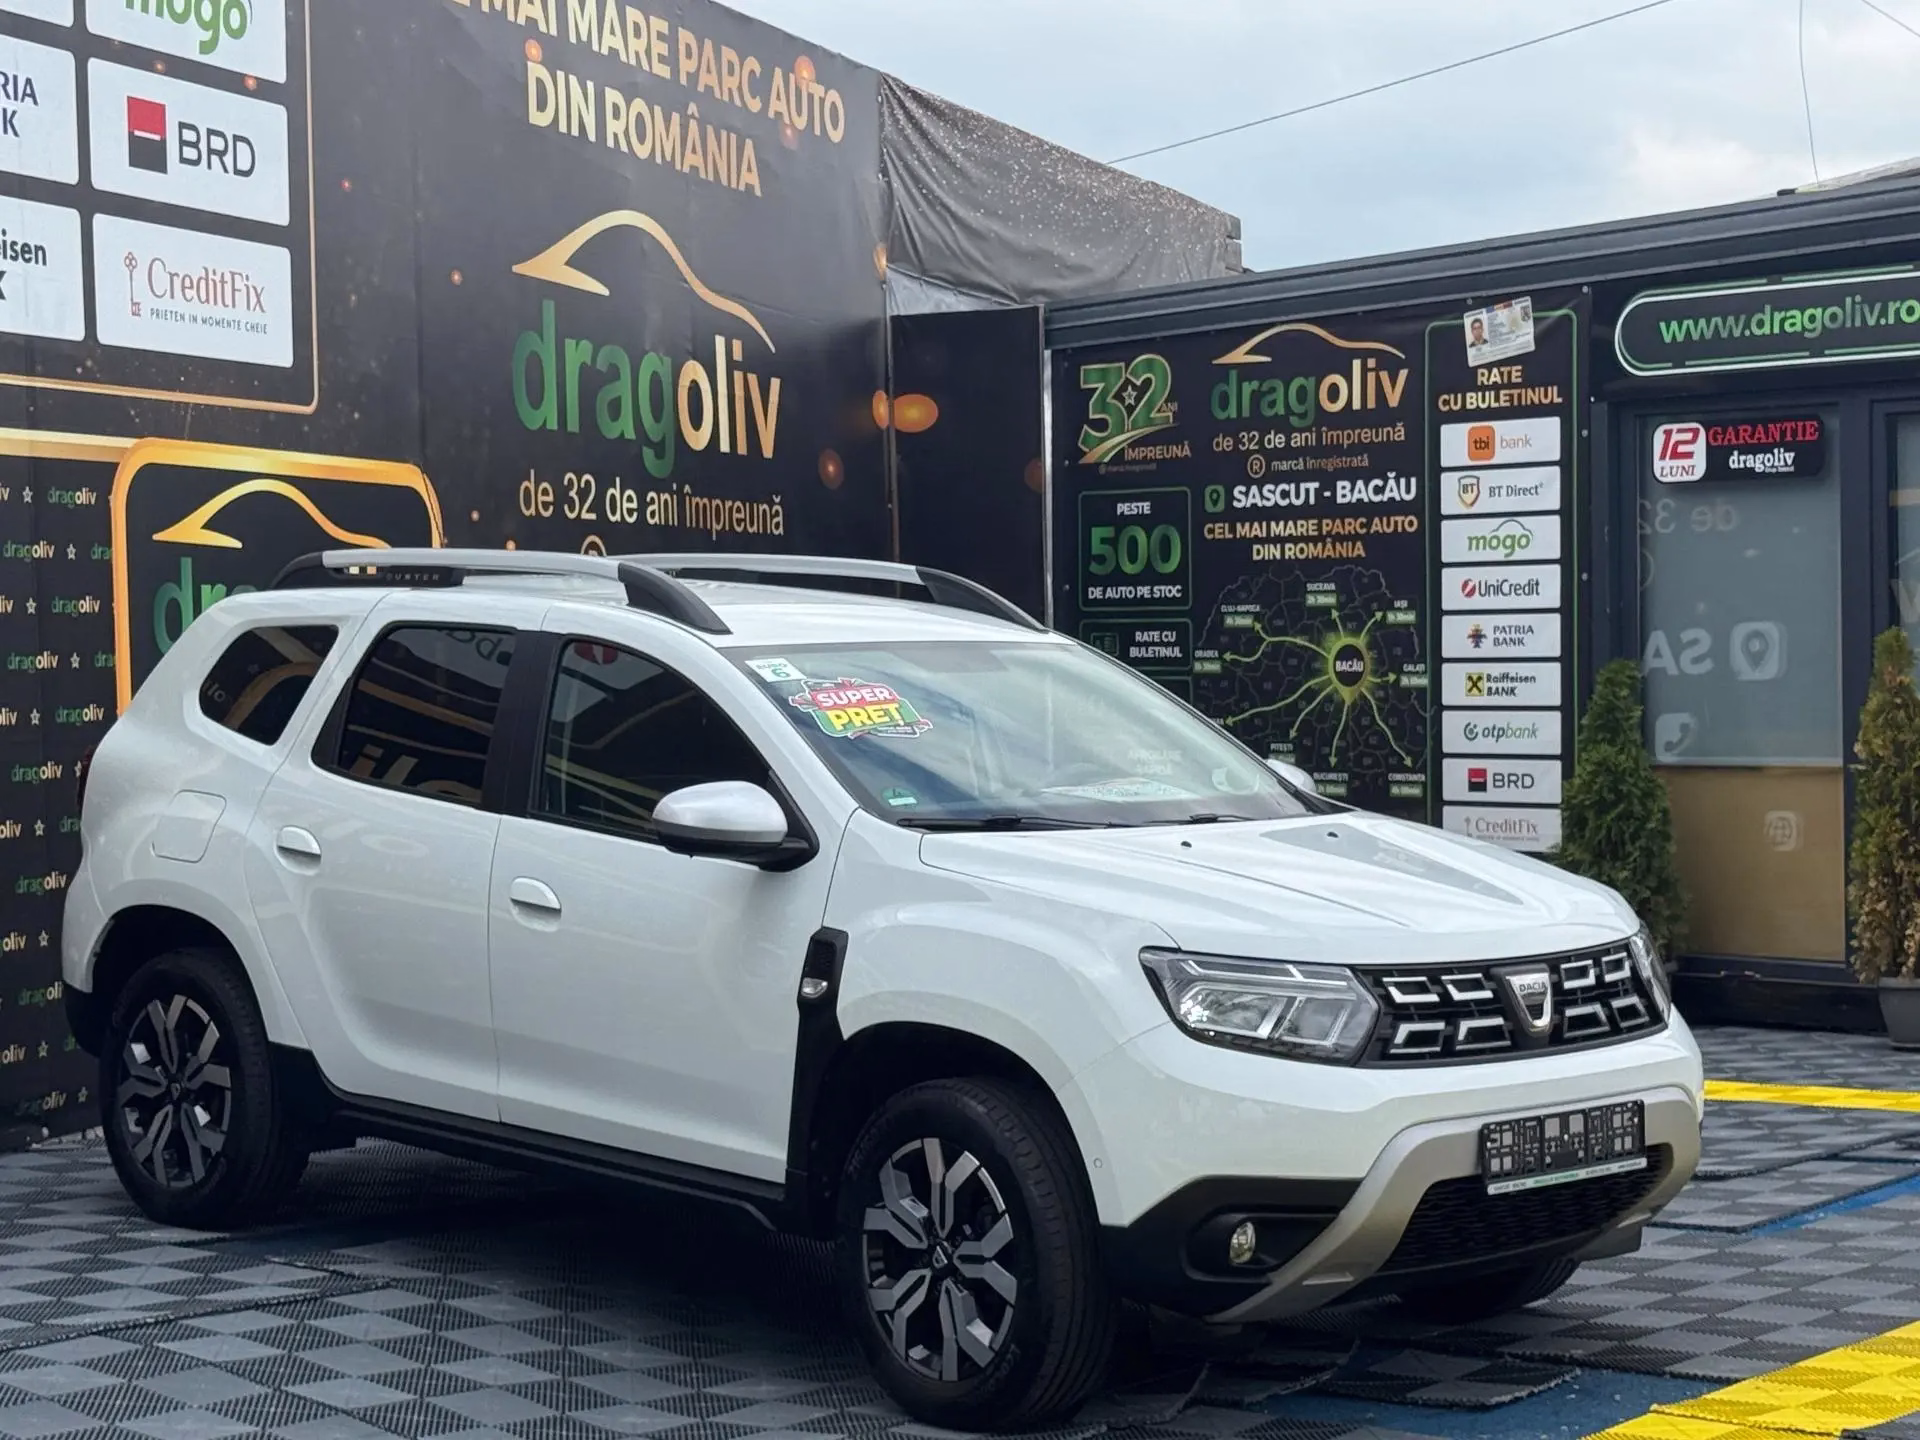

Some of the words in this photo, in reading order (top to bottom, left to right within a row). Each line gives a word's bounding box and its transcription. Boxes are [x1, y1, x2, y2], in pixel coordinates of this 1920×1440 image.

[568, 0, 671, 80] MARE
[678, 27, 762, 113] PARC
[768, 66, 845, 144] AUTO
[527, 60, 596, 143] DIN
[605, 86, 762, 197] ROMÂNIA
[178, 121, 256, 178] BRD
[0, 228, 47, 267] isen
[147, 257, 267, 315] CreditFix
[150, 307, 186, 323] PRIETEN
[188, 314, 198, 325] IN
[201, 316, 242, 331] MOMENTE
[245, 321, 268, 335] CHEIE
[1659, 293, 1920, 344] www.dragoliv.ro
[1477, 366, 1523, 386] RATE
[512, 299, 781, 480] dragoliv
[1210, 357, 1409, 428] dragoliv
[1438, 393, 1461, 411] CU
[1465, 385, 1563, 410] BULETINUL
[1078, 353, 1172, 452] 32
[1212, 433, 1234, 451] de
[1238, 431, 1260, 450] 32
[1264, 429, 1286, 448] de
[1290, 426, 1316, 447] ani
[1321, 421, 1406, 449] împreună
[1473, 436, 1490, 451] tbi
[1500, 433, 1533, 449] bank
[1658, 427, 1700, 461] 12
[1708, 420, 1820, 446] GARANTIE
[1123, 440, 1192, 461] ÎMPREUNĂ
[1728, 446, 1796, 472] dragoliv
[1271, 457, 1304, 472] marcă
[1305, 453, 1369, 472] înregistrată
[1659, 465, 1697, 478] LUNI
[48, 486, 97, 508] dragoliv
[1232, 481, 1320, 509] SASCUT
[1335, 471, 1417, 505] BACĂU
[1462, 482, 1476, 495] BT
[1488, 486, 1503, 498] BT
[519, 469, 554, 518] de
[563, 472, 597, 520] 32
[605, 477, 638, 524] de
[646, 483, 678, 527] ani
[684, 484, 784, 541] împreună
[1116, 502, 1152, 516] PESTE
[1204, 523, 1234, 540] CEL
[1235, 521, 1265, 539] MAI
[1270, 519, 1319, 537] MARE
[1322, 517, 1367, 535] PARC
[1370, 515, 1418, 533] AUTO
[3, 540, 55, 563] dragoliv
[1088, 524, 1182, 575] 500
[1252, 544, 1281, 561] DIN
[1284, 537, 1366, 559] ROMÂNIA
[1467, 533, 1531, 559] mogo
[1088, 586, 1103, 600] DE
[1105, 585, 1135, 599] AUTO
[1136, 585, 1152, 599] PE
[1153, 584, 1183, 598] STOC
[1478, 578, 1541, 598] UniCredit
[51, 596, 101, 618] dragoliv
[1135, 631, 1161, 643] RATE
[1161, 631, 1177, 642] CU
[1493, 624, 1534, 636] PATRIA
[1129, 646, 1183, 659] BULETINUL
[1493, 636, 1526, 648] BANK
[7, 651, 59, 674] dragoliv
[771, 667, 791, 679] 6
[1335, 658, 1364, 673] BACĂU
[1486, 672, 1537, 684] Raiffeisen
[816, 687, 892, 707] SUPER
[1486, 686, 1518, 697] BANK
[55, 703, 105, 726] dragoliv
[1482, 721, 1539, 743] otpbank
[11, 761, 63, 784] dragoliv
[1492, 772, 1535, 790] BRD
[1475, 817, 1538, 835] CreditFix
[15, 871, 67, 895] dragoliv
[18, 981, 64, 1007] dragoli
[1518, 981, 1548, 992] DACIA
